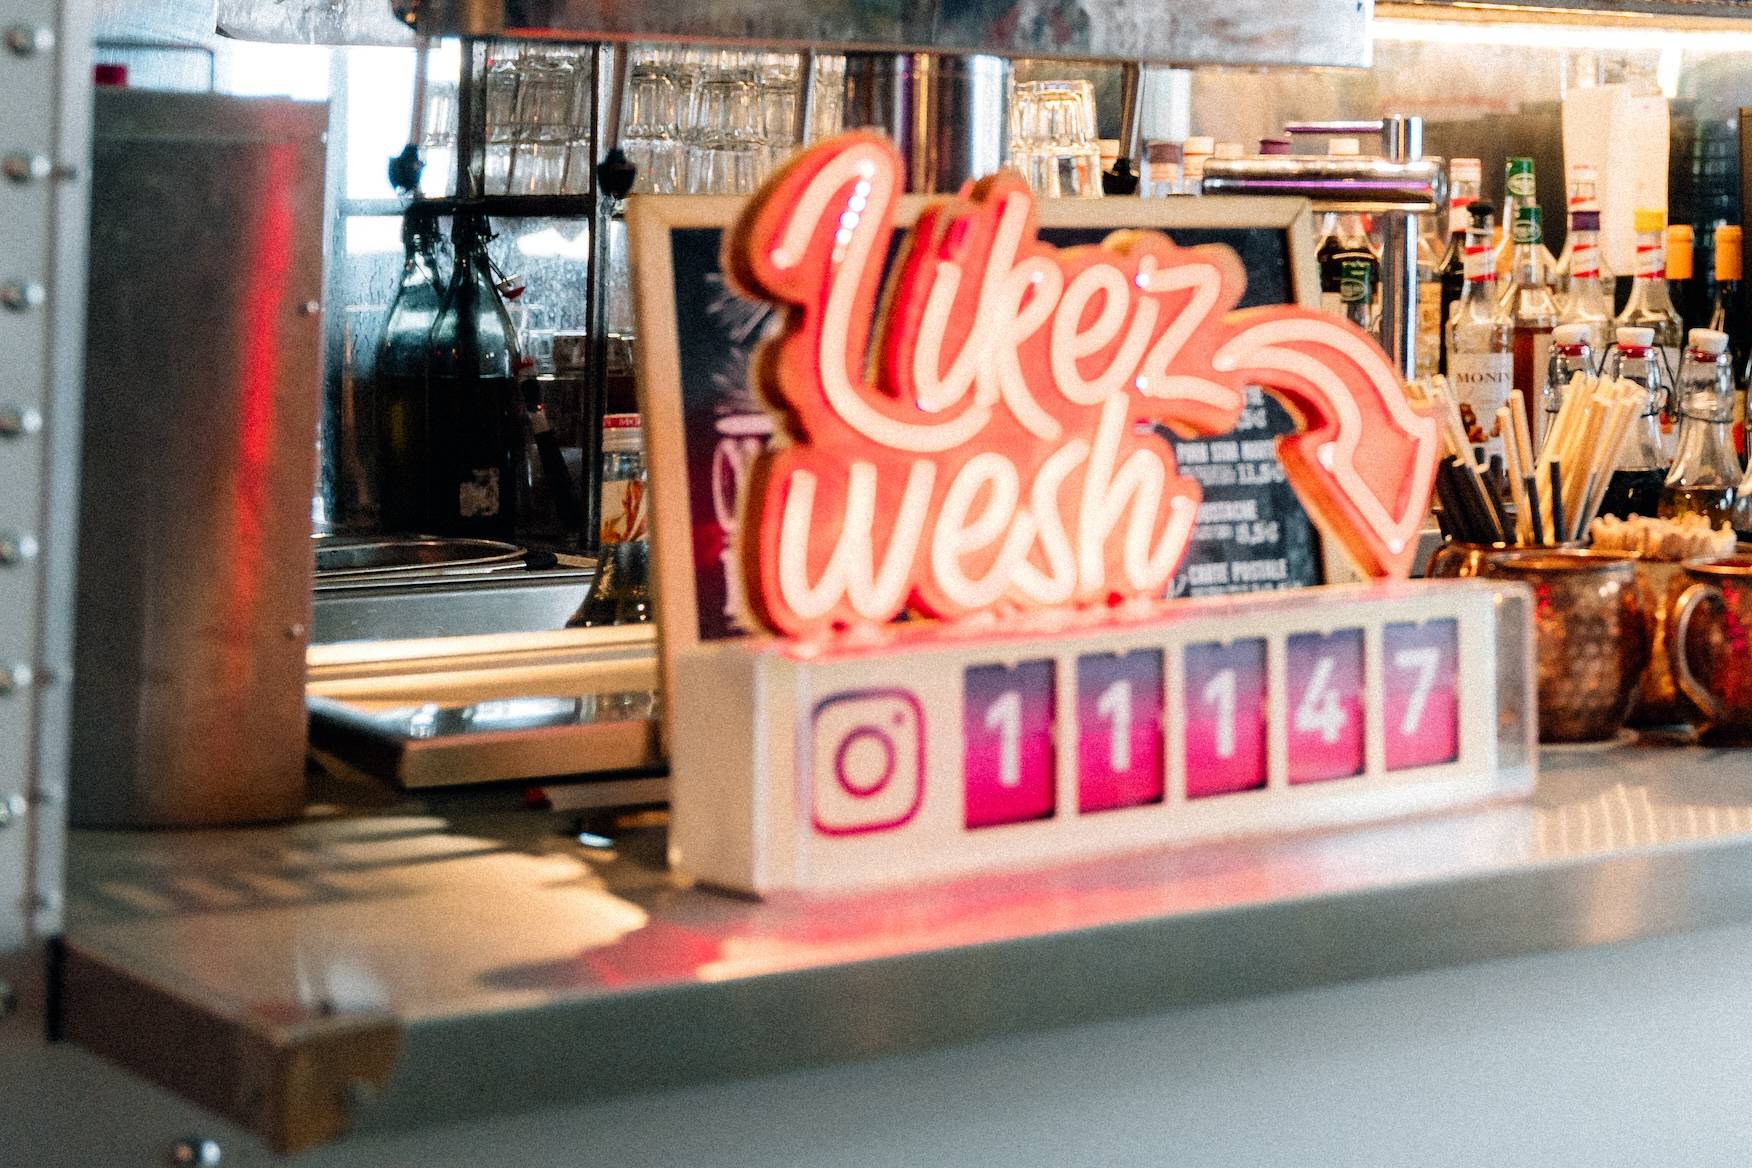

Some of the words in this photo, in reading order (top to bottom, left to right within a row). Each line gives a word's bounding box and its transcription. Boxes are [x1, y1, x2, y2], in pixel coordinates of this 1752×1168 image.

[770, 138, 1246, 454] Likez
[776, 392, 1200, 624] wesh
[983, 644, 1442, 788] 11147
